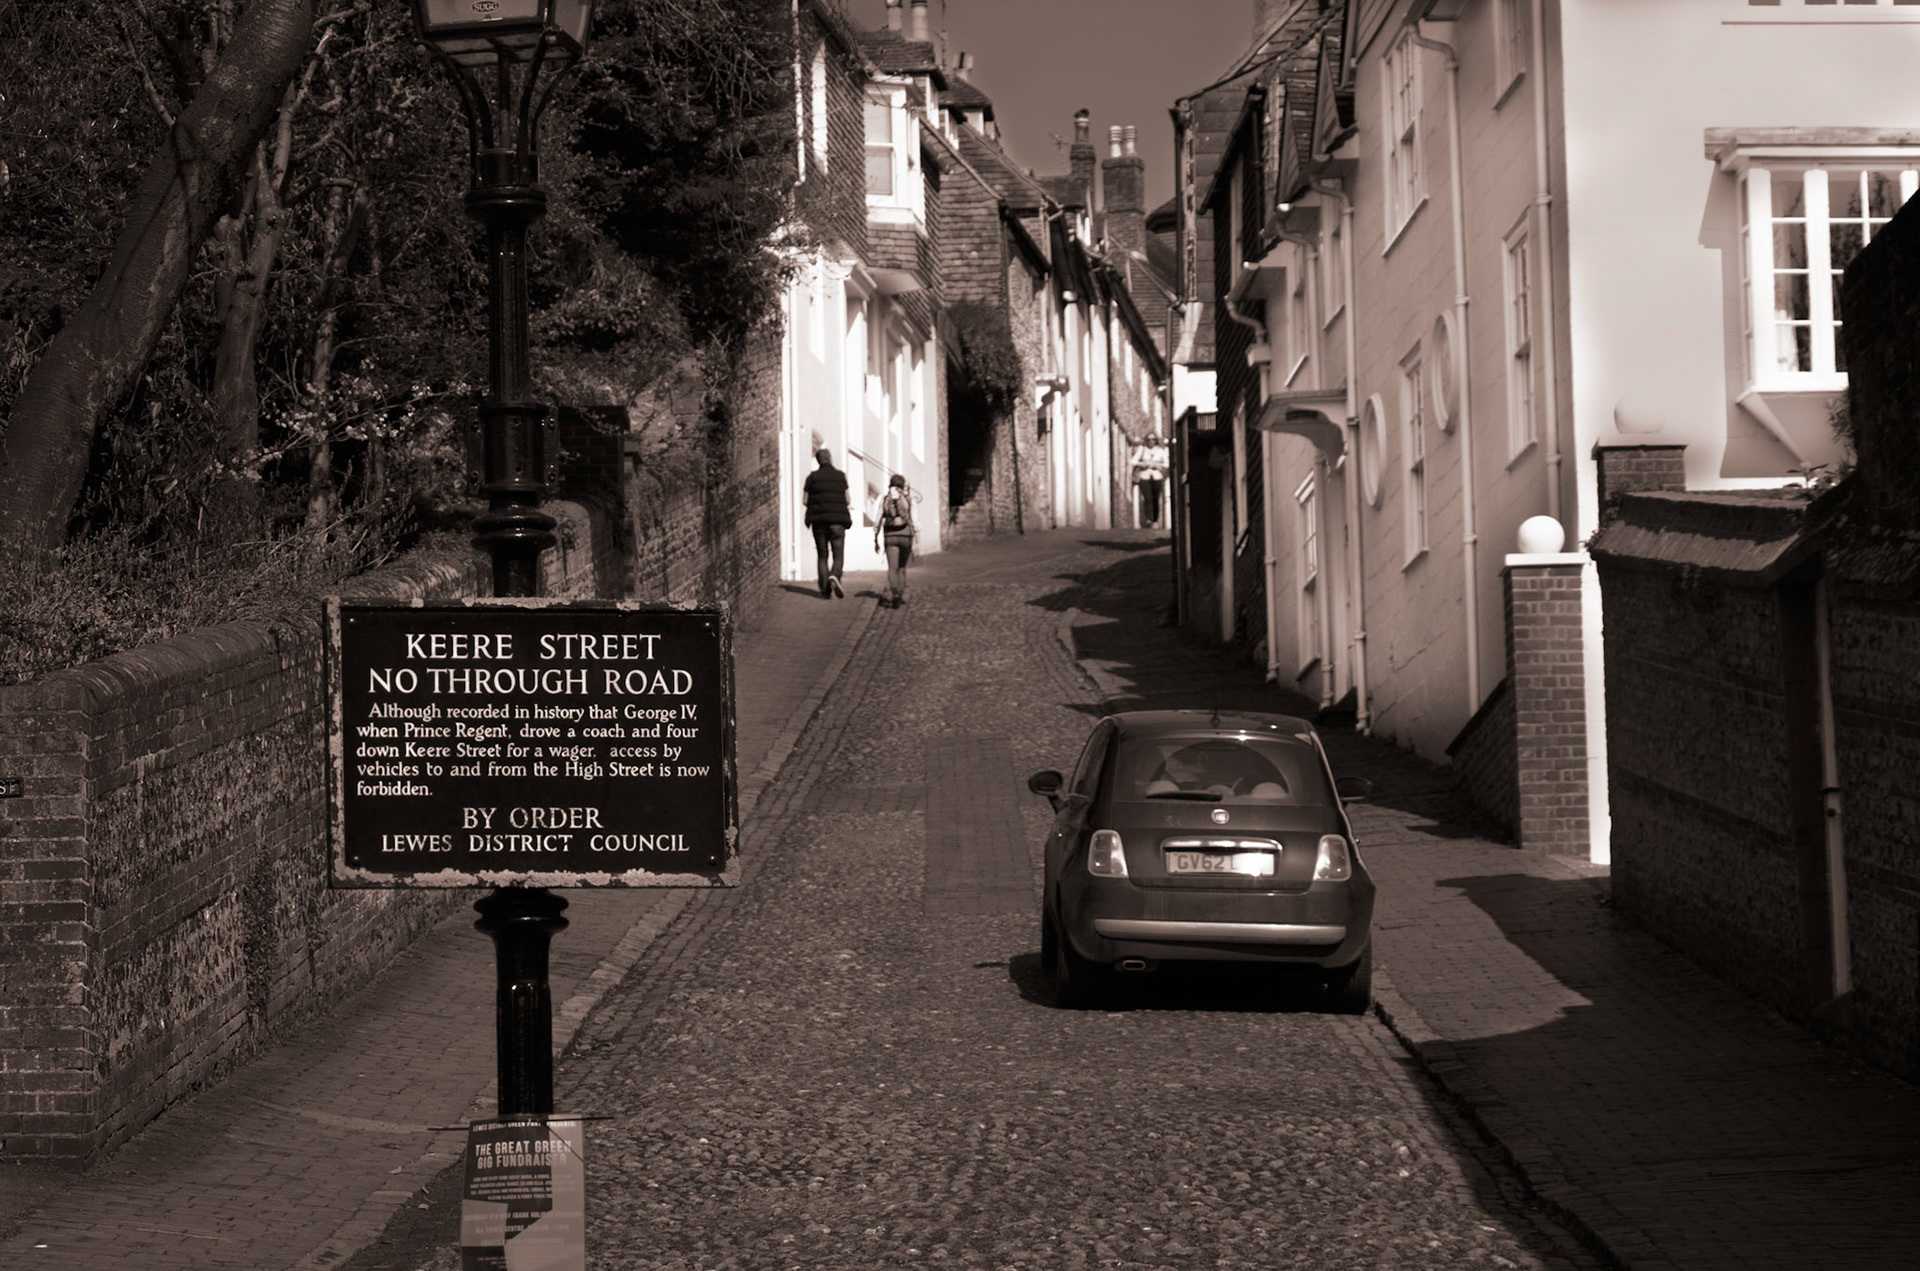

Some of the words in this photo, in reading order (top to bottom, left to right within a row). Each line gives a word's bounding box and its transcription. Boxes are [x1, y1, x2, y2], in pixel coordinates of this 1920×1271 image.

[474, 2, 497, 11] SUGG
[406, 634, 513, 659] KEERE
[540, 634, 661, 659] STREET
[369, 668, 417, 693] NO
[427, 668, 588, 694] THROUGH
[604, 669, 692, 695] ROAD
[368, 703, 441, 721] Although
[447, 704, 509, 718] recorded
[515, 705, 529, 718] in
[534, 704, 584, 722] history
[589, 704, 618, 719] that
[624, 704, 677, 723] George
[680, 704, 698, 721] IV,
[356, 723, 398, 737] when
[404, 723, 451, 737] Prince
[455, 723, 511, 741] Regent,
[520, 723, 560, 737] drove
[567, 728, 576, 737] a
[583, 723, 625, 738] coach
[632, 723, 660, 738] and
[664, 722, 698, 738] four
[356, 743, 399, 757] down
[405, 743, 450, 757] Keere
[457, 742, 501, 757] Street
[507, 743, 530, 757] for
[534, 747, 543, 757] a
[610, 747, 657, 757] access
[663, 744, 681, 761] by
[357, 762, 419, 776] vehicles
[426, 762, 443, 776] to
[450, 762, 481, 776] and
[488, 761, 526, 776] from
[534, 761, 558, 776] the
[565, 761, 603, 780] High
[609, 762, 654, 776] Street
[660, 763, 671, 777] is
[677, 766, 709, 776] now
[357, 781, 432, 796] forbidden.
[463, 808, 496, 829] BY
[510, 808, 604, 828] ORDER
[382, 835, 452, 852] LEWES
[469, 834, 573, 852] DISTRICT
[590, 835, 689, 851] COUNCIL
[1178, 854, 1225, 870] GV62
[475, 1143, 492, 1157] THE
[495, 1140, 531, 1154] GREAT
[534, 1139, 572, 1153] GREEN
[477, 1156, 493, 1170] GIG
[496, 1153, 567, 1168] FUNDRAISER
